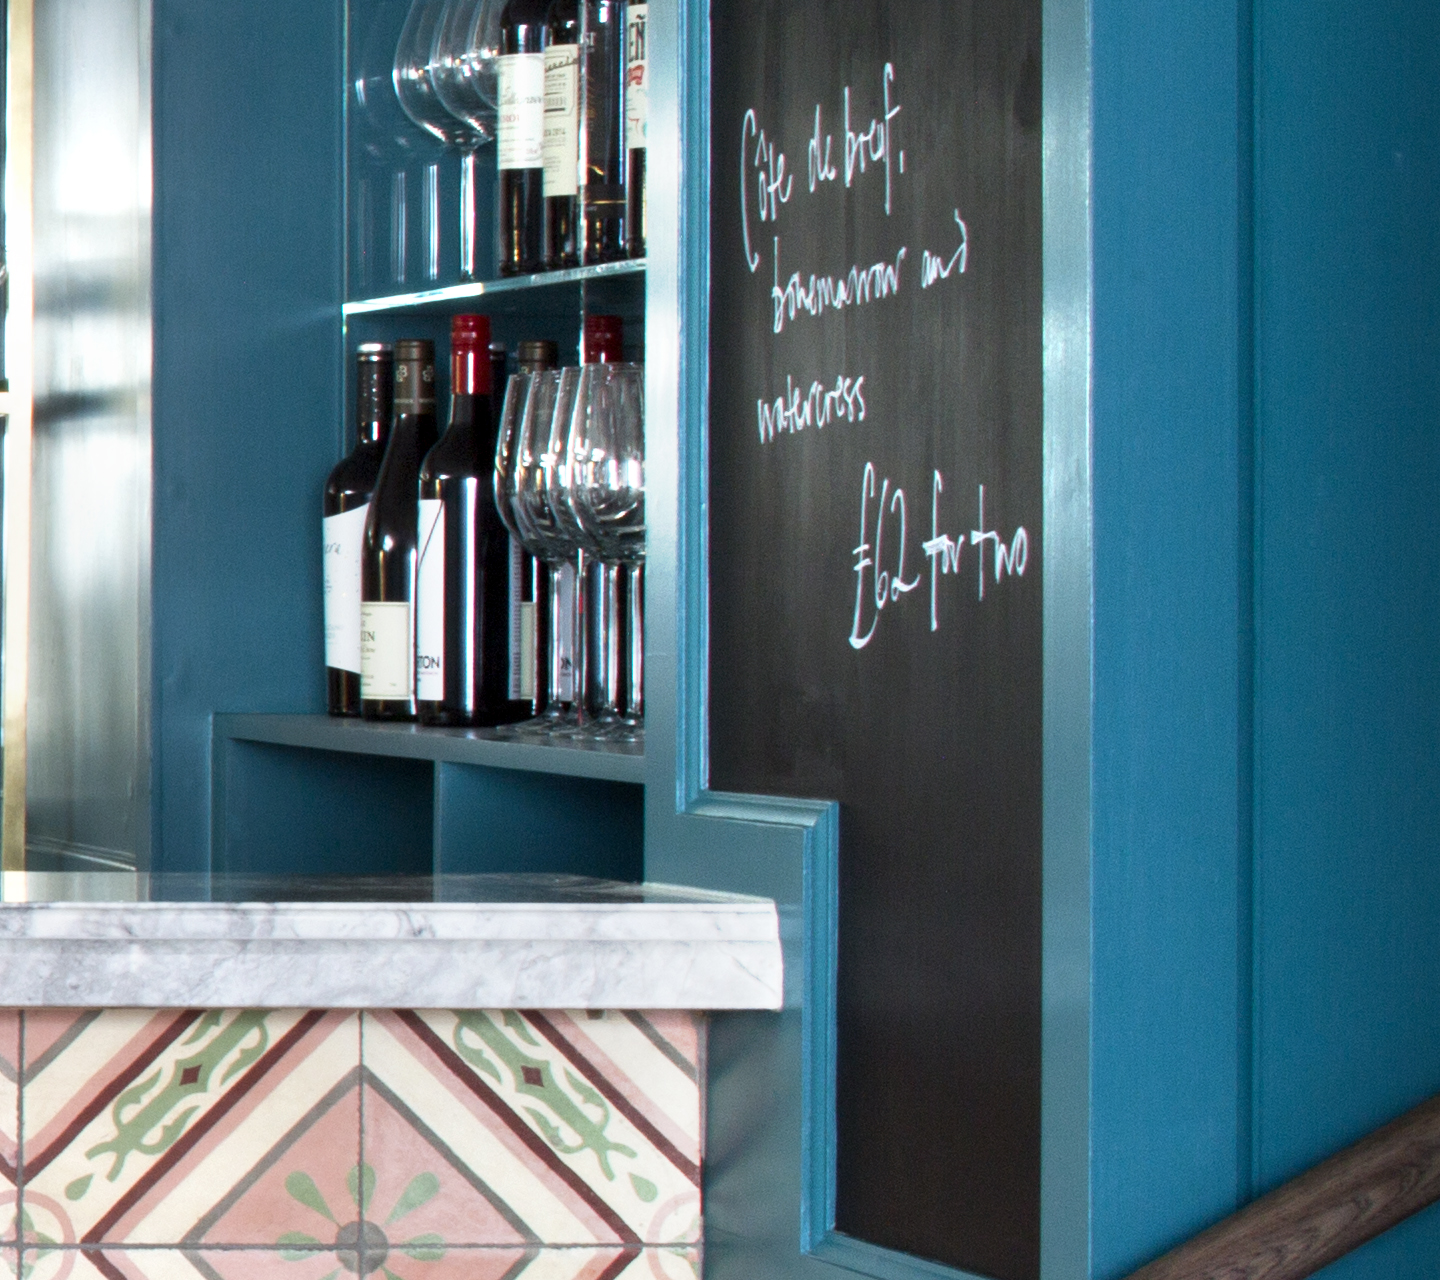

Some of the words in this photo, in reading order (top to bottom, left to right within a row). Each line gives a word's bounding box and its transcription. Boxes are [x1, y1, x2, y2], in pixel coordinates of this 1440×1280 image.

[808, 104, 837, 194] de
[920, 209, 968, 289] and
[756, 374, 867, 444] watercress
[847, 460, 920, 650] £62
[922, 468, 966, 632] for
[969, 483, 1030, 601] two
[417, 655, 441, 669] TON
